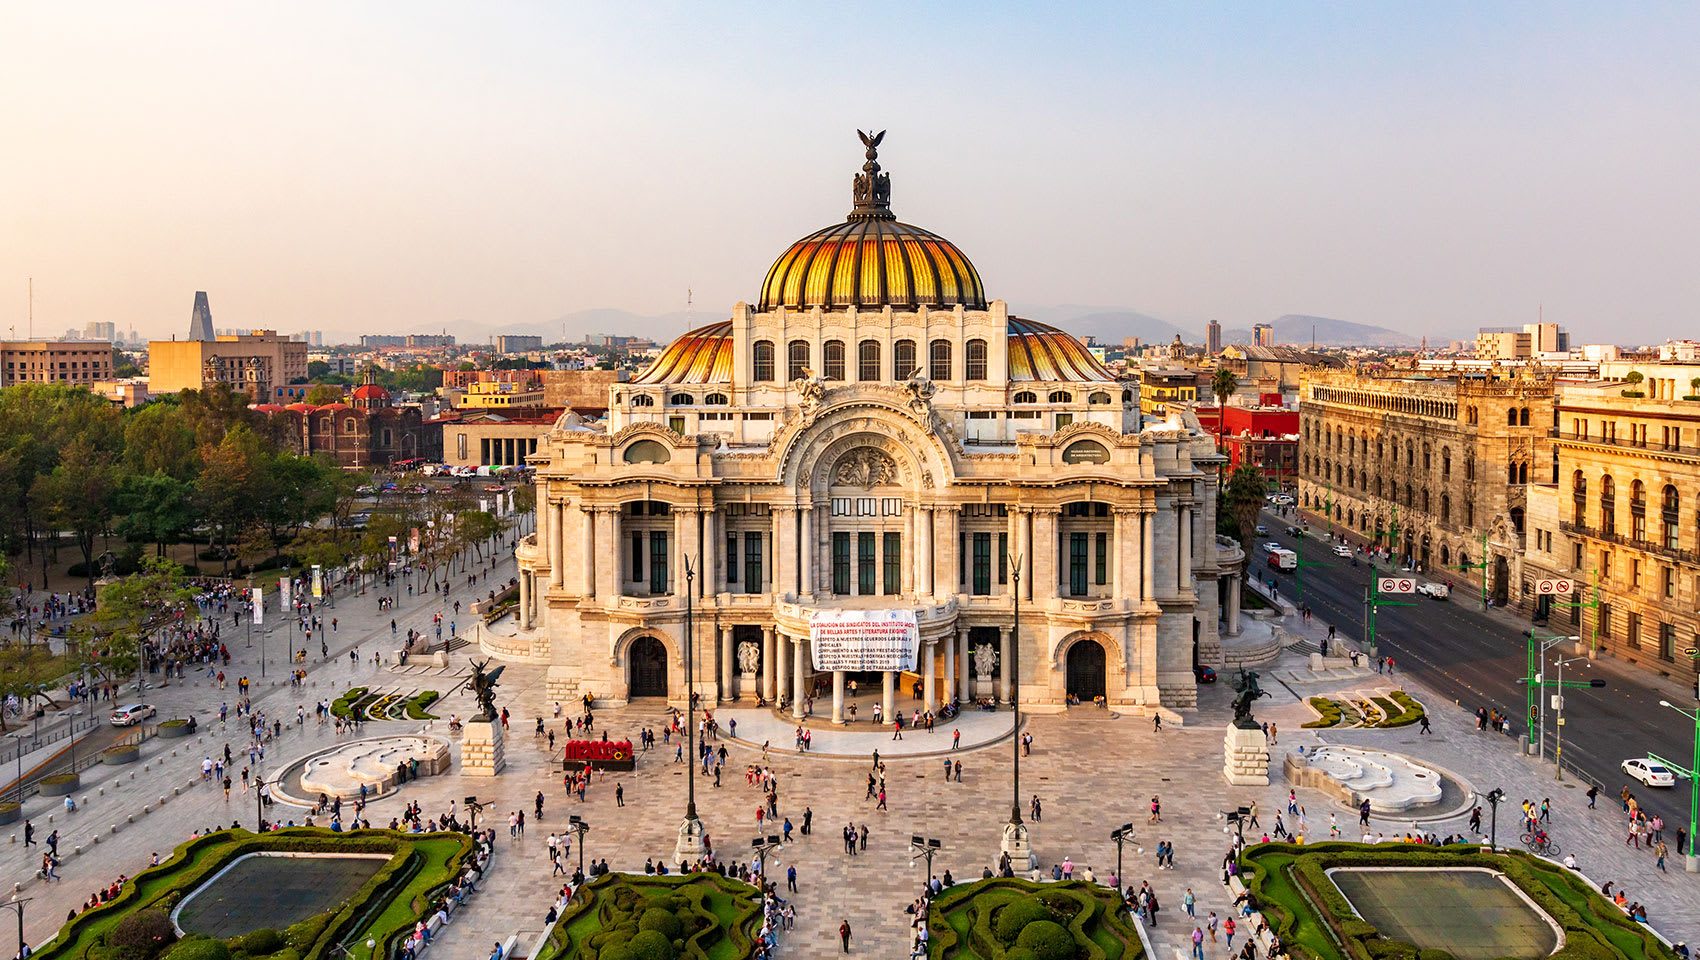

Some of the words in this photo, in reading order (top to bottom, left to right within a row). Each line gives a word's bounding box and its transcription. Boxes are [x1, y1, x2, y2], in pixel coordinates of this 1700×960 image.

[820, 447, 840, 483] PALACIO
[844, 440, 856, 450] DE
[860, 438, 896, 453] BELLAS
[897, 455, 912, 483] ARTES
